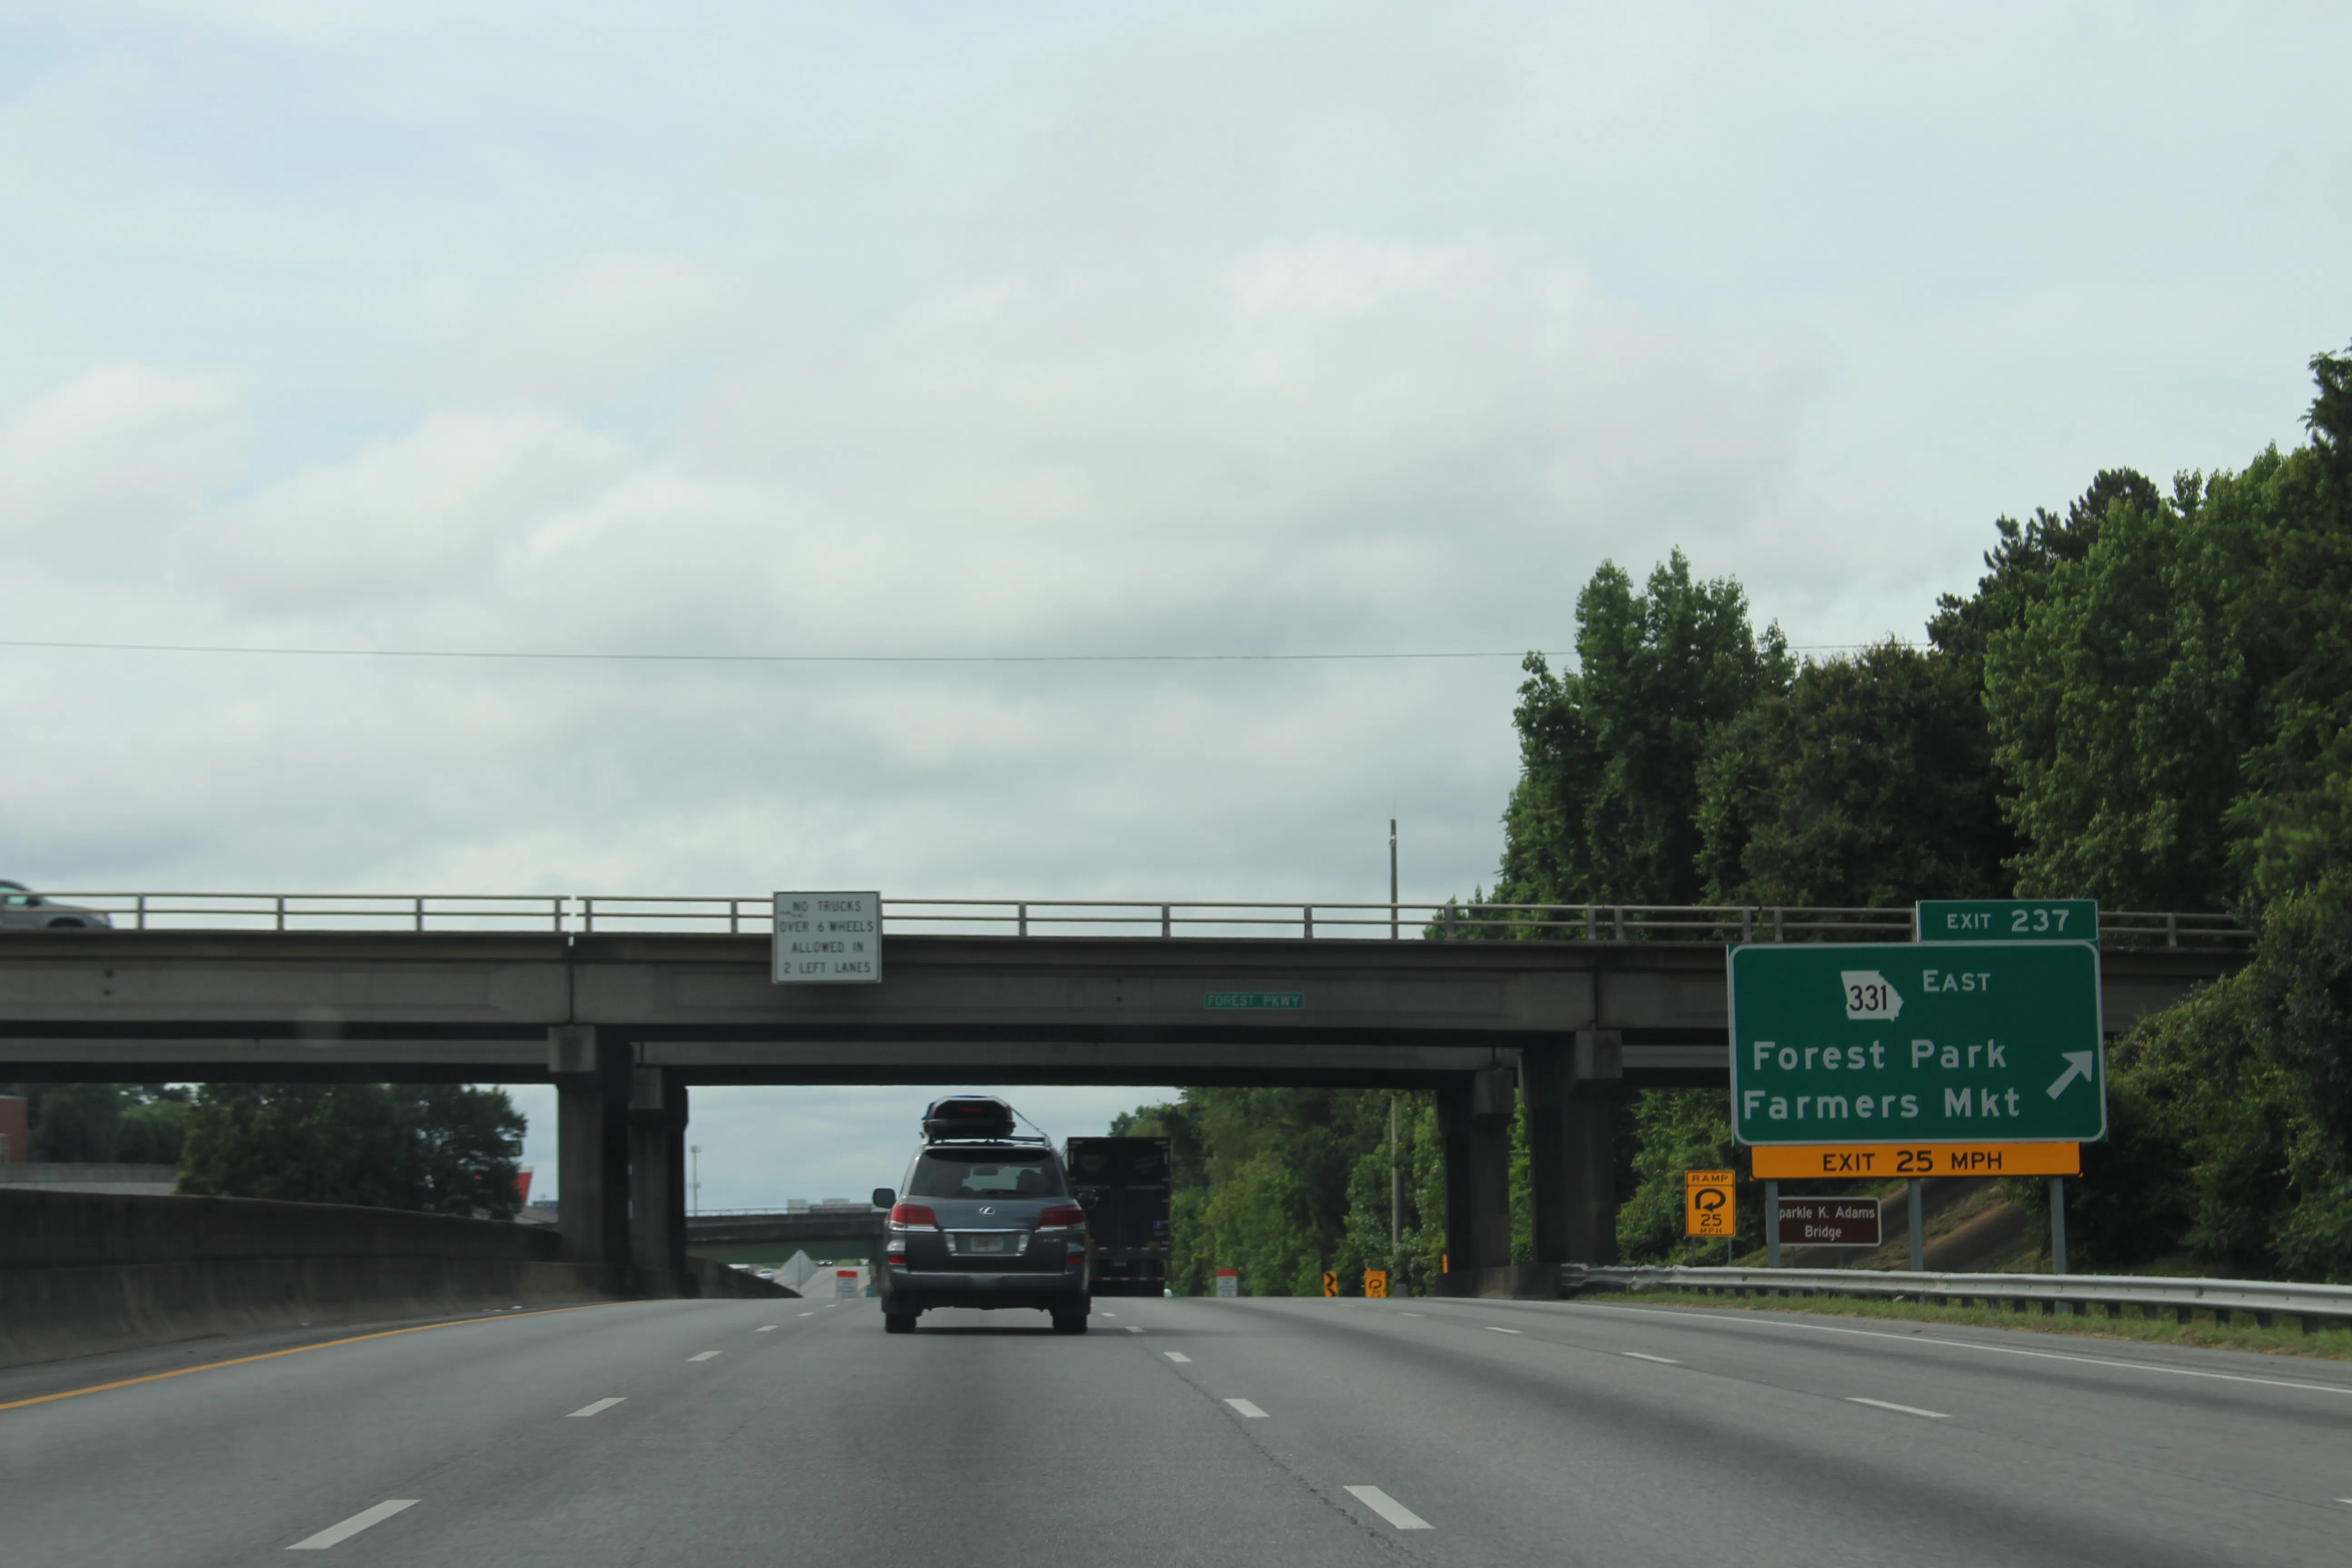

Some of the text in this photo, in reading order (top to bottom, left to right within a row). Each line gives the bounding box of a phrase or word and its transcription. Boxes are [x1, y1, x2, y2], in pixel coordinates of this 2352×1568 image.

[792, 901, 861, 912] NO TRUCKS
[779, 921, 873, 932] OVER 6 WHEELS
[1947, 910, 2069, 931] EXIT 237
[792, 941, 863, 952] ALLOWED IN
[784, 962, 870, 974] 2 LEFT LANES
[1923, 970, 1990, 992] EAST
[1208, 995, 1299, 1006] FOREST PKWY
[1849, 985, 1887, 1011] 331
[1754, 1039, 2007, 1070] Forest Park
[1744, 1088, 2019, 1120] Farmers Mkt
[1823, 1151, 2002, 1171] EXIT 25 MPH
[1701, 1214, 1722, 1226] 25
[1779, 1206, 1875, 1221] parkle K. Adams
[1805, 1225, 1842, 1241] Bridge
